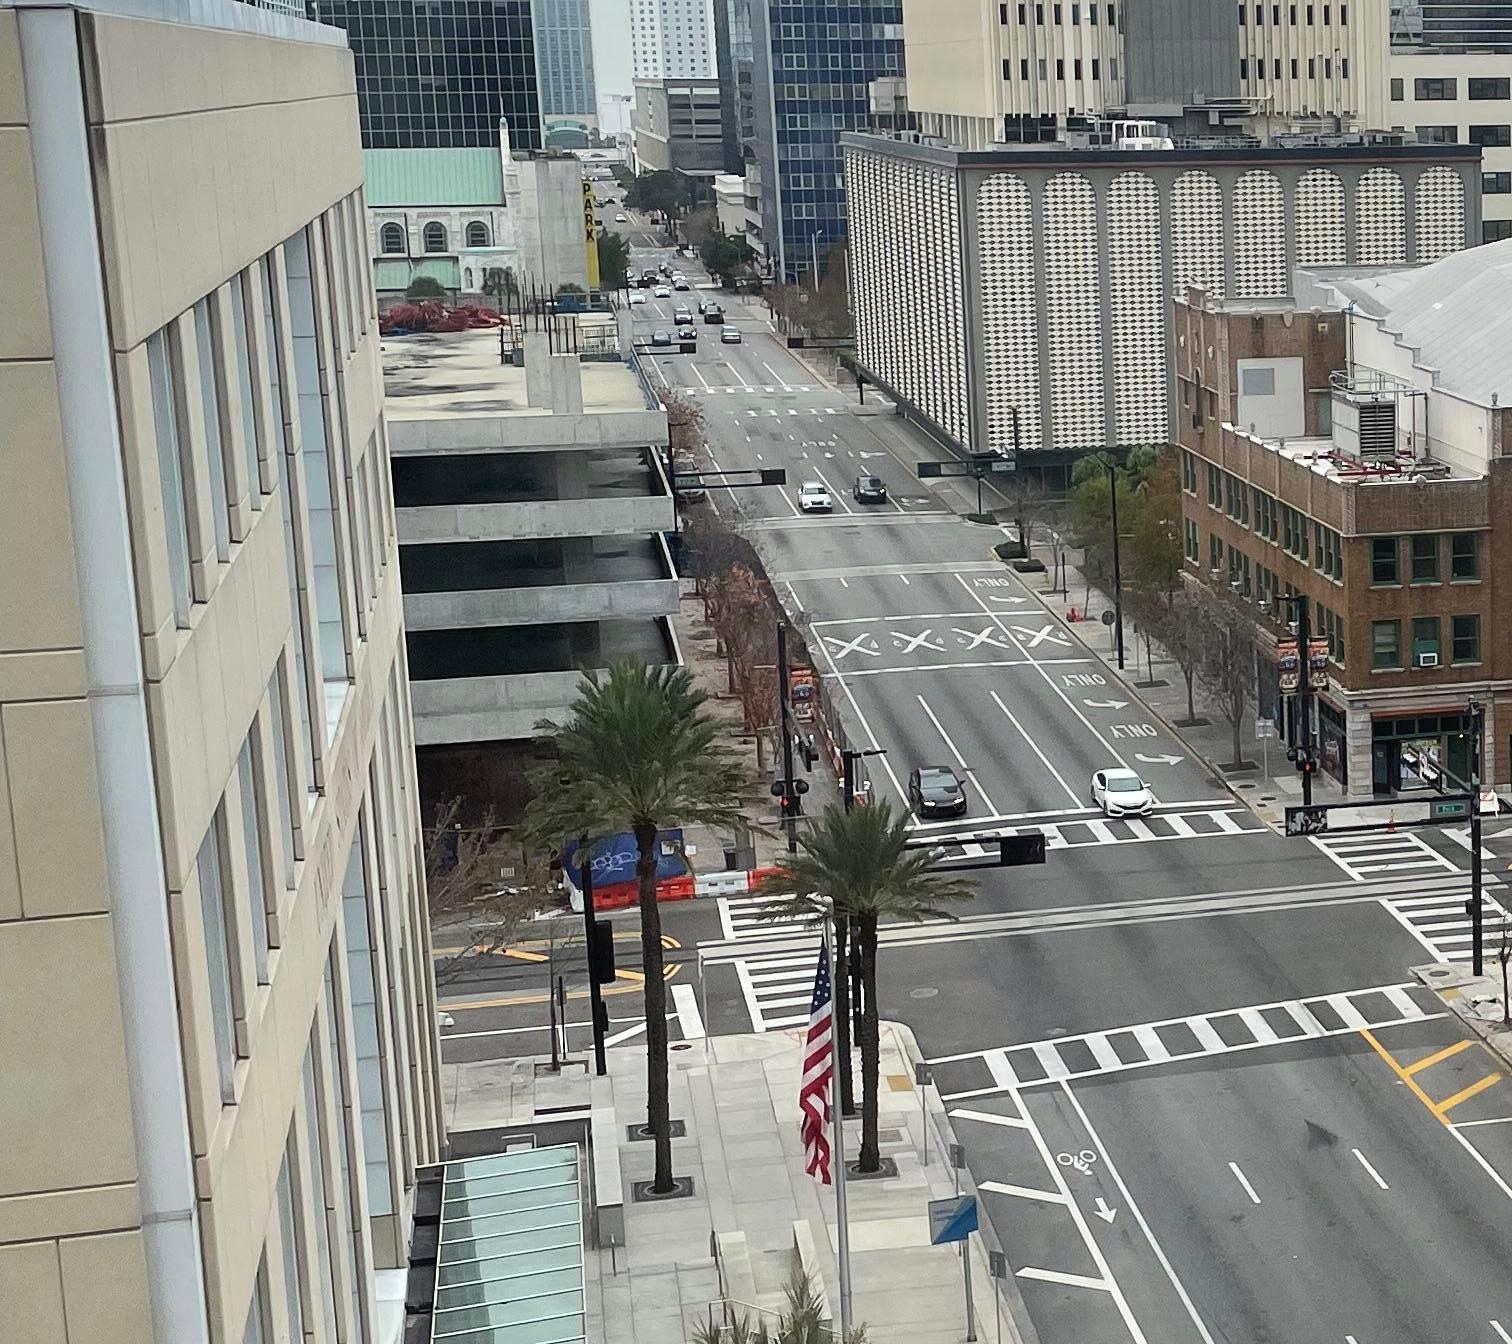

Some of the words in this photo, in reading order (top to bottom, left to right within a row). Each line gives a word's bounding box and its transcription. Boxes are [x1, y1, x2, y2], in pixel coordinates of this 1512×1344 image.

[582, 183, 595, 242] PARK
[973, 578, 1010, 587] ONLY
[1062, 674, 1107, 687] ONLY
[1110, 723, 1158, 739] ONLY
